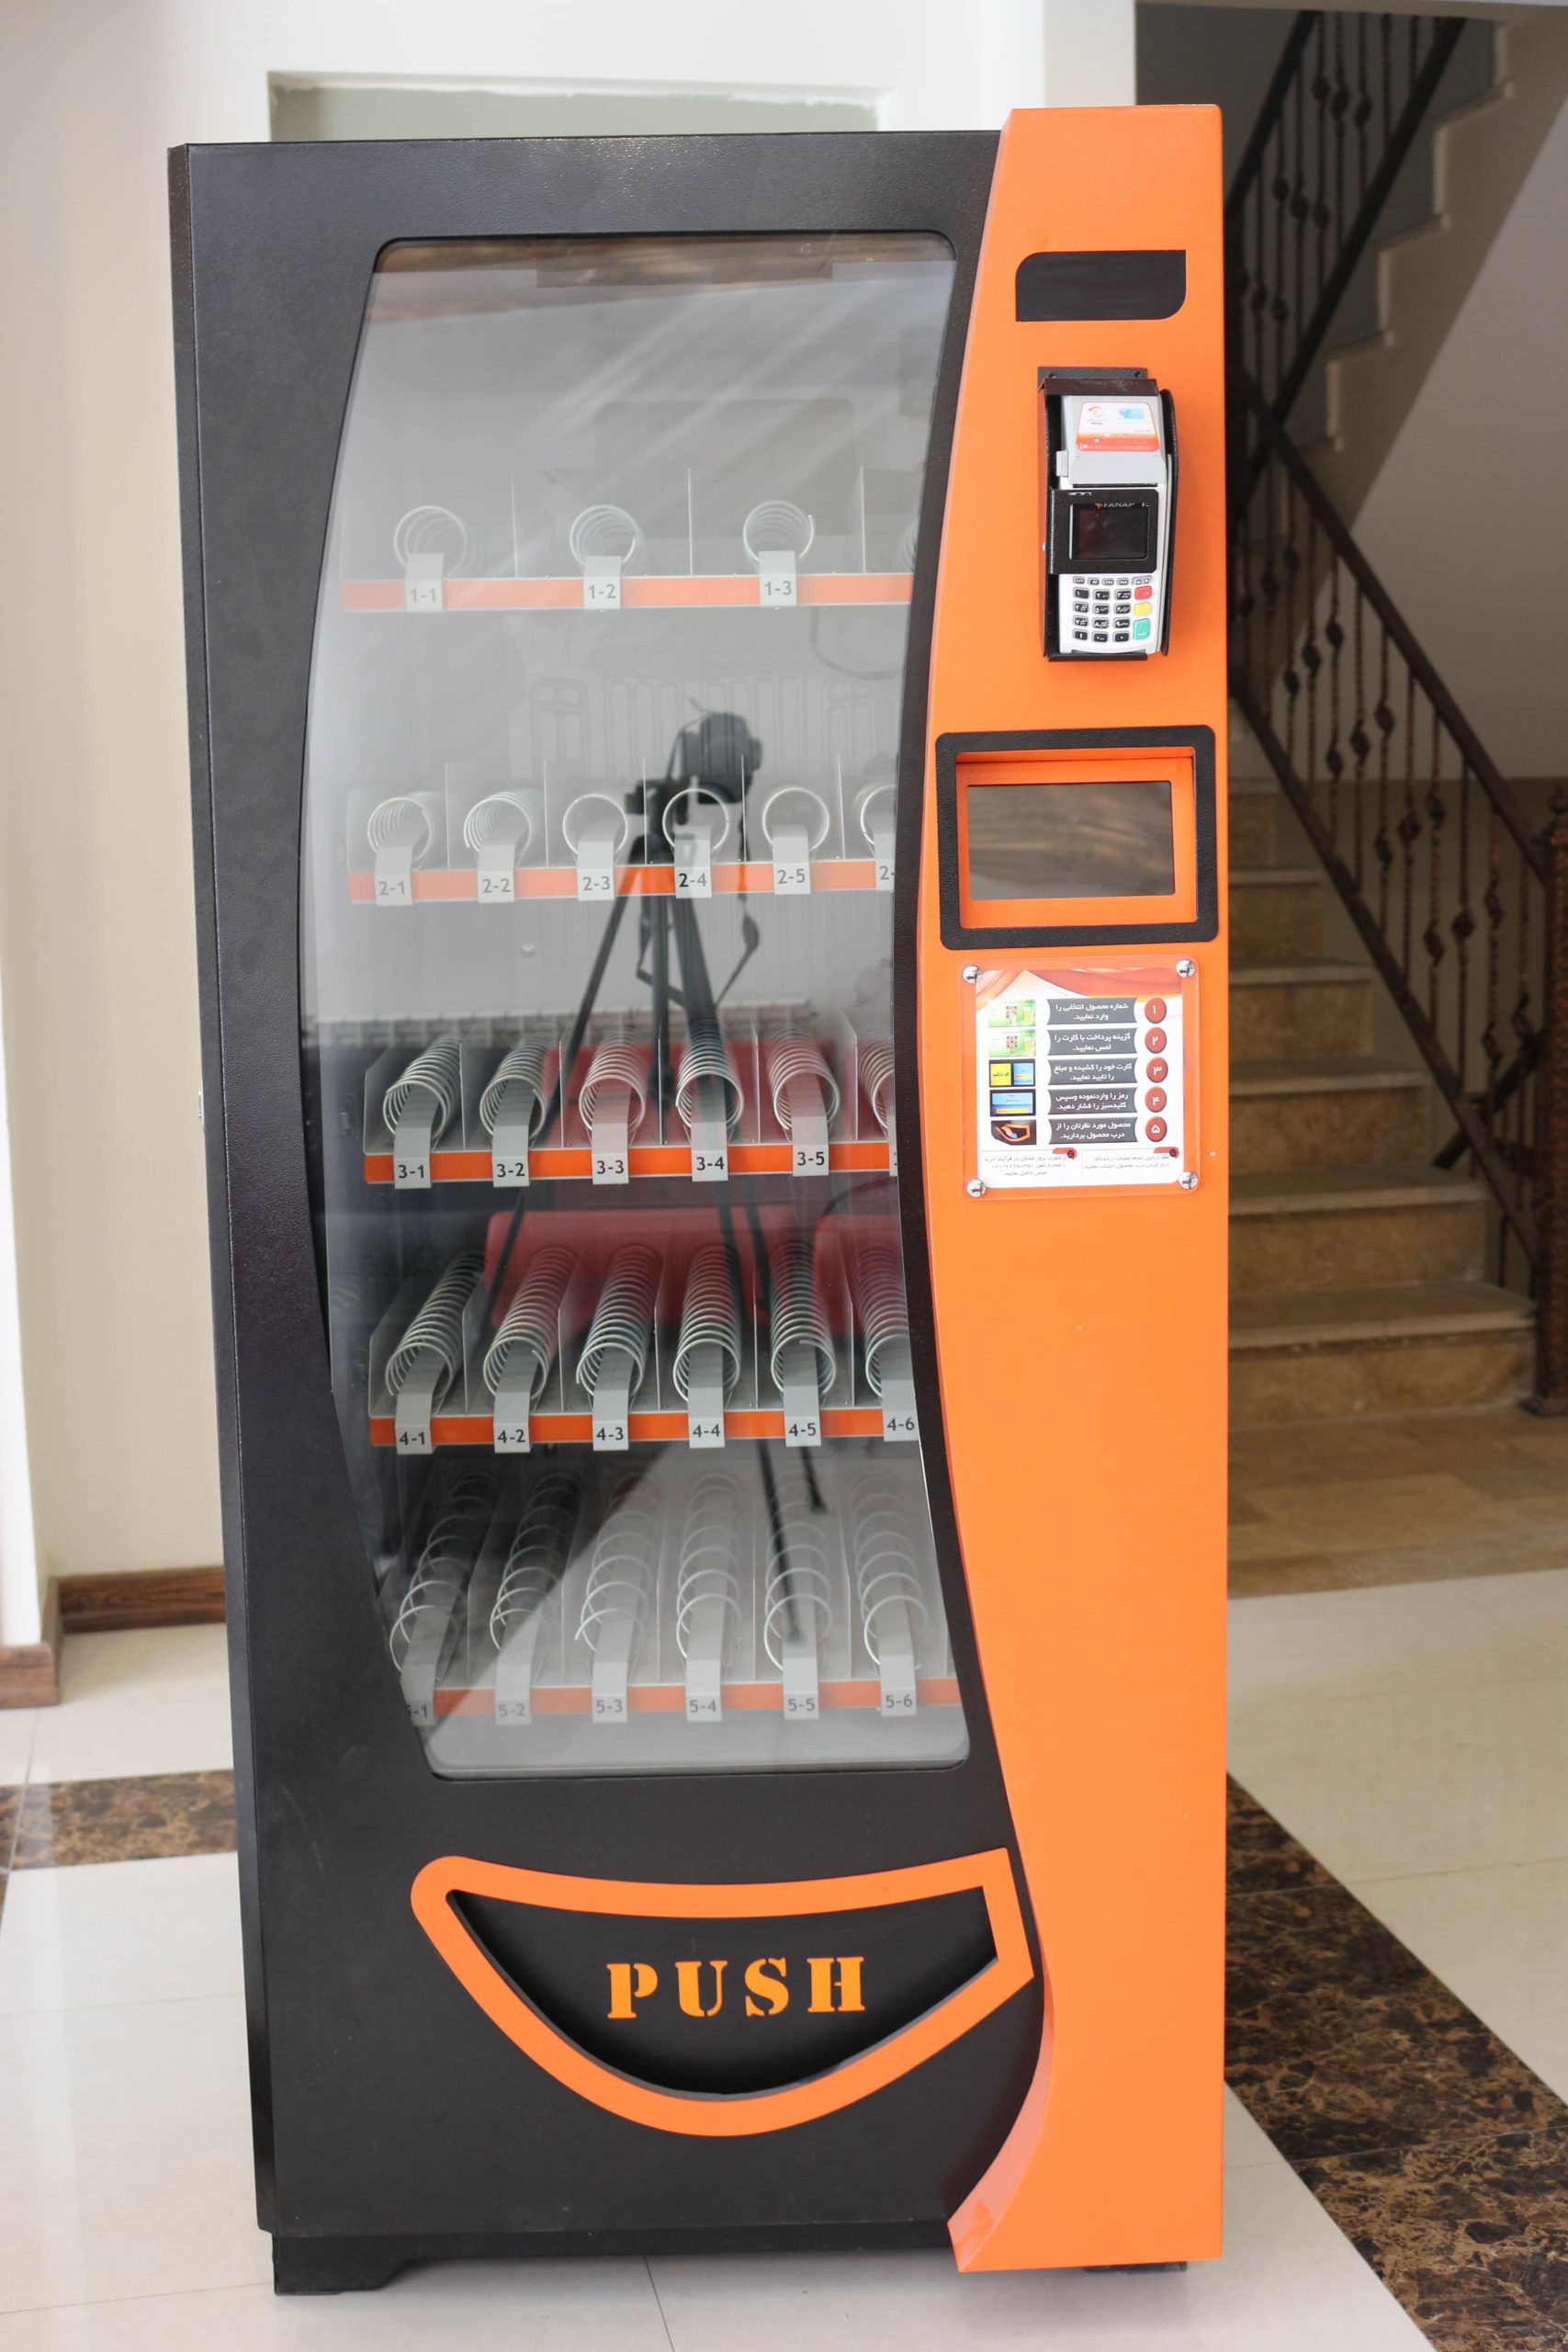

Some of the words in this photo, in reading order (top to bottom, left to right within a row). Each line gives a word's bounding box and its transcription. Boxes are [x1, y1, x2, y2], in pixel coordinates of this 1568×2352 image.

[411, 588, 436, 603] 1-1
[588, 583, 616, 599] 1-2
[764, 581, 792, 596] 1-3
[679, 872, 707, 888] 2-4
[777, 868, 806, 884] 2-5
[879, 865, 895, 880] 2-
[378, 880, 405, 896] 2-1
[481, 877, 512, 893] 2-2
[582, 876, 611, 891] 2-3
[1086, 1003, 1109, 1012] محصول
[1153, 1004, 1156, 1014] ۱
[1055, 1035, 1061, 1043] را
[1086, 1034, 1111, 1042] پرداخت
[1152, 1035, 1158, 1046] ۲
[1054, 1065, 1067, 1074] مبلغ
[1153, 1066, 1162, 1076] ۳
[1152, 1096, 1161, 1106] ۴
[1151, 1124, 1161, 1134] ۵
[696, 1156, 725, 1170] 3-4
[796, 1151, 825, 1166] 3-5
[398, 1164, 424, 1179] 3-1
[496, 1162, 525, 1177] 3-2
[596, 1159, 625, 1174] 3-3
[692, 1423, 720, 1438] 4-4
[788, 1422, 817, 1437] 4-5
[887, 1418, 915, 1431] 4-6
[399, 1430, 425, 1445] 4-1
[497, 1429, 526, 1443] 4-2
[595, 1427, 624, 1442] 4-3
[595, 1700, 623, 1713] 5-3
[689, 1699, 717, 1713] 5-4
[787, 1697, 816, 1712] 5-5
[885, 1693, 913, 1708] 5-6
[499, 1703, 526, 1717] 5-2
[606, 1956, 866, 2019] PUSH
